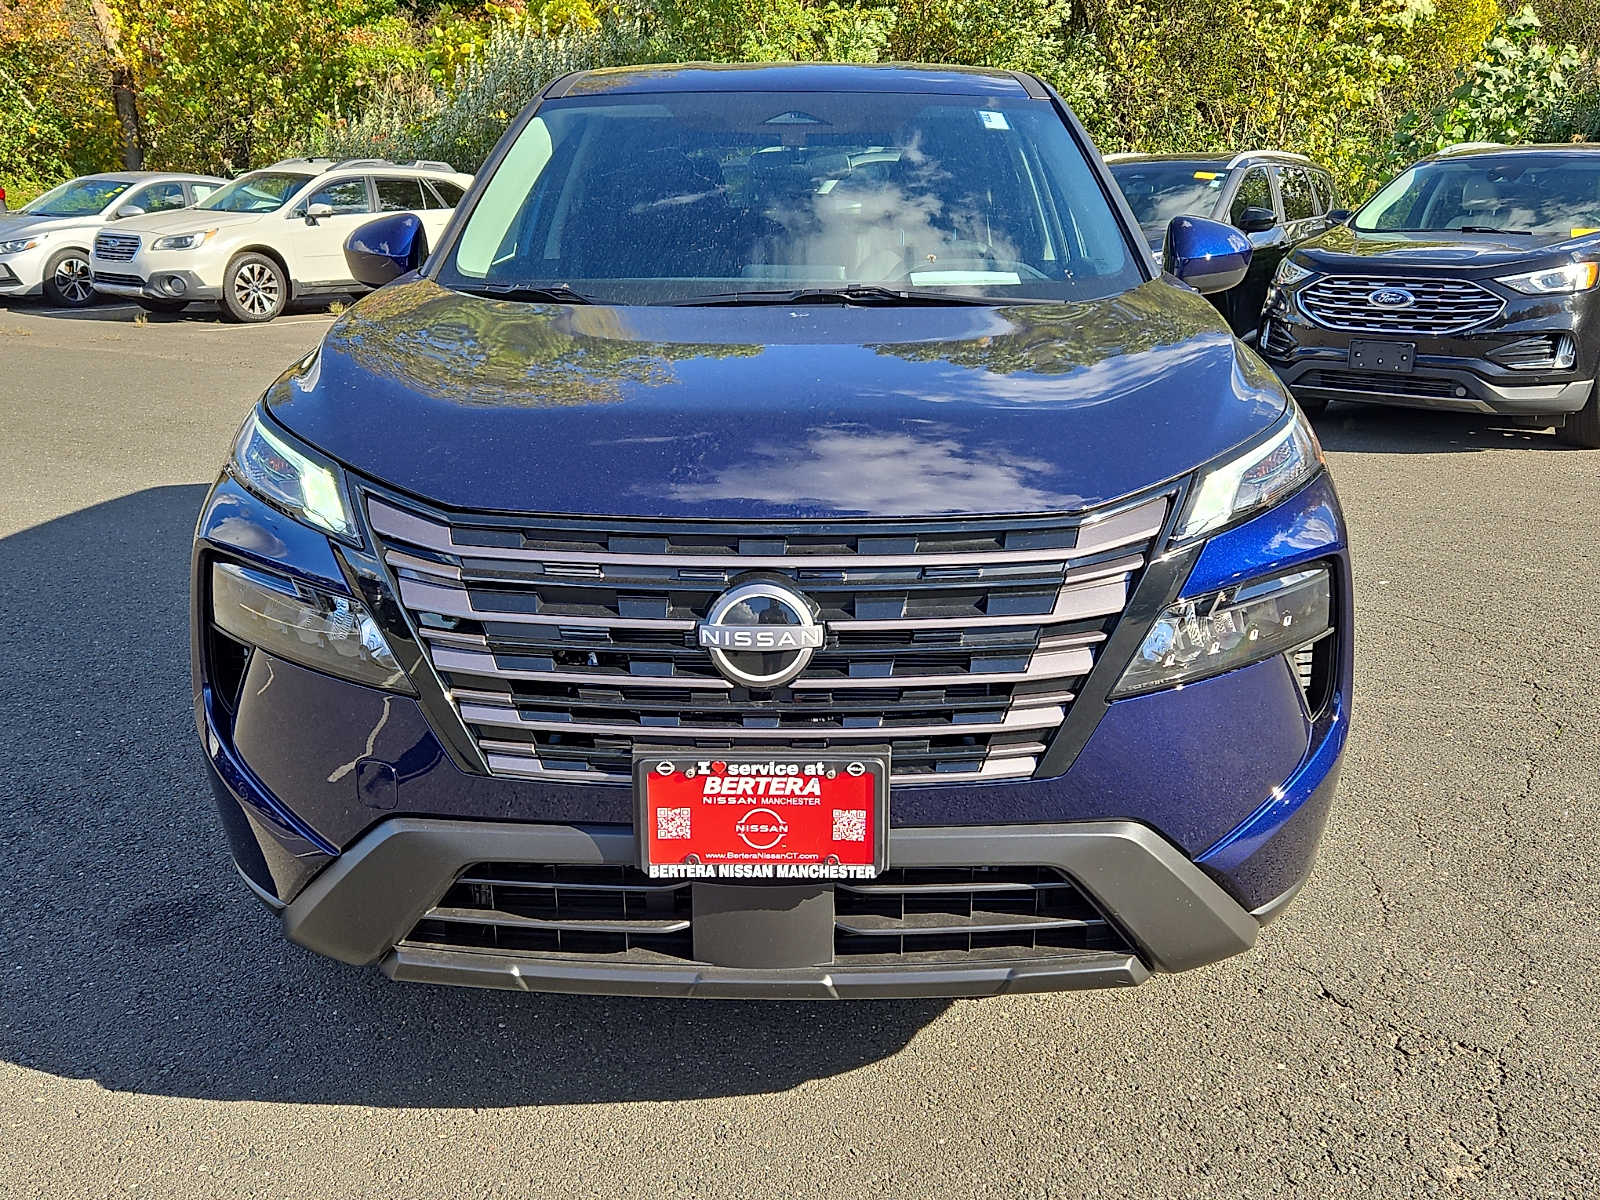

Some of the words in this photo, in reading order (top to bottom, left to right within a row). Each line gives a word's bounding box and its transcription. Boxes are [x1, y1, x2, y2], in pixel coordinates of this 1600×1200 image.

[701, 629, 820, 647] NISSAN
[698, 761, 711, 775] I
[728, 761, 798, 776] service
[804, 761, 824, 776] at
[703, 776, 821, 796] BERTERA
[702, 796, 757, 805] NISSAN
[761, 797, 821, 806] MANCHESTER
[735, 824, 788, 833] NISSAN
[705, 851, 819, 860] www.BerteraNissanCT.com
[650, 864, 716, 878] BERTERA
[718, 864, 774, 878] NISSAN
[776, 864, 877, 879] MANCHESTER
